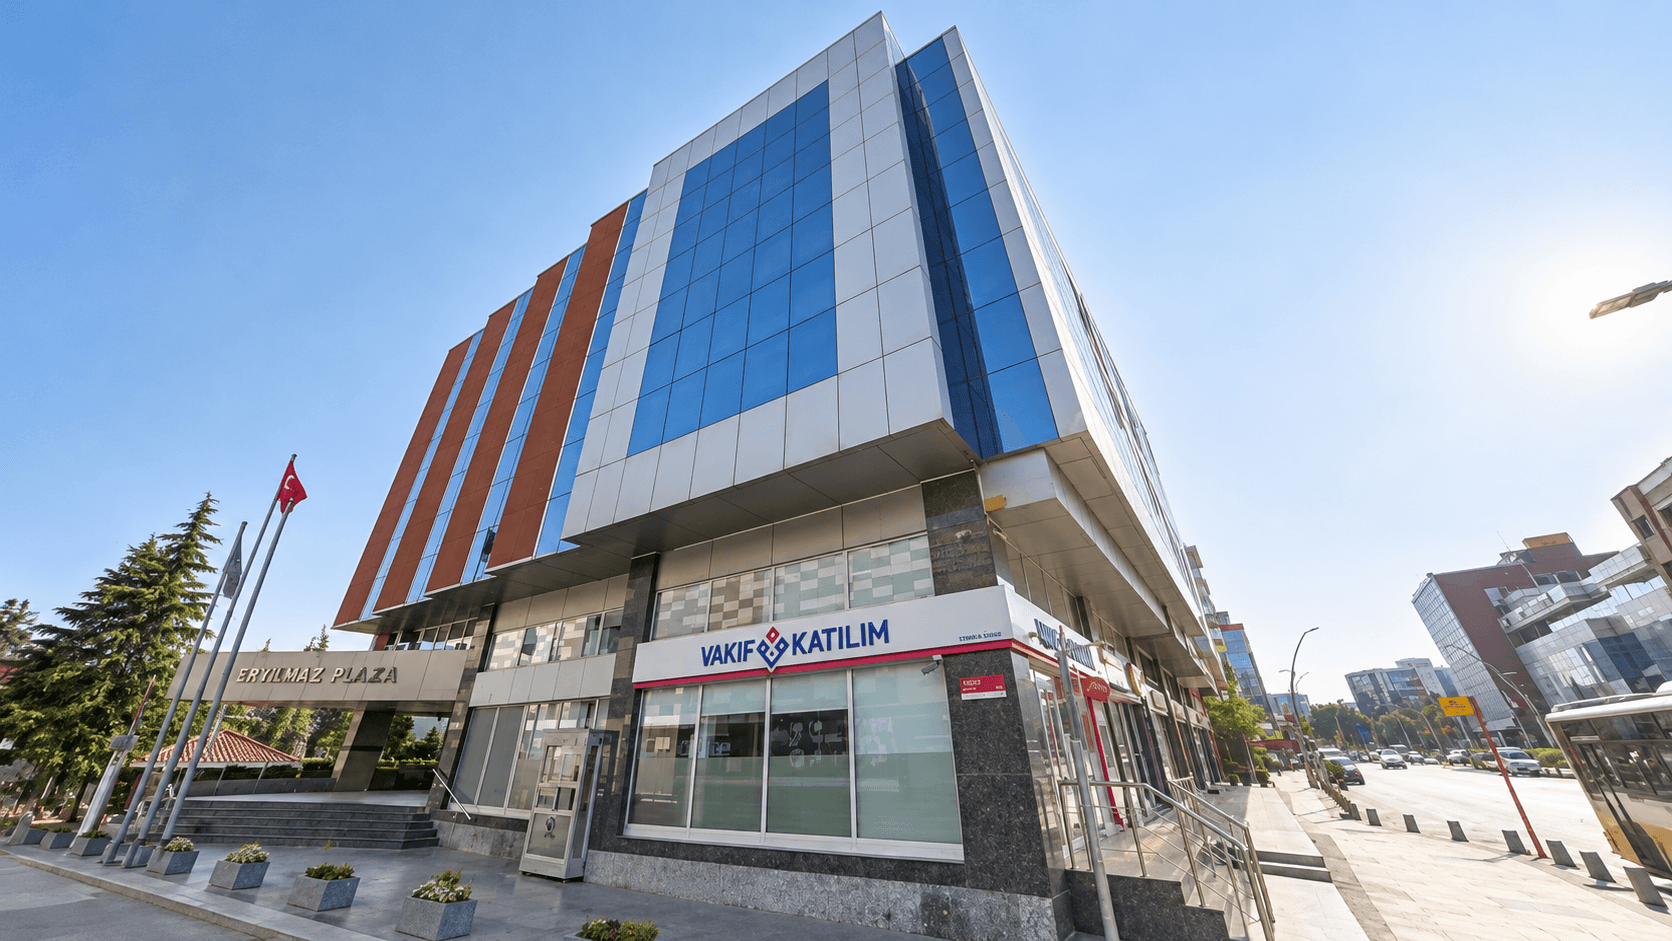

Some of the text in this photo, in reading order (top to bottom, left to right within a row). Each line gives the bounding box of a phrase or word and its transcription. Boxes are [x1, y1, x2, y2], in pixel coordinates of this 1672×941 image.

[701, 619, 890, 667] VAKIF KATILIM
[236, 666, 398, 684] ERYILMAZ PLAZA
